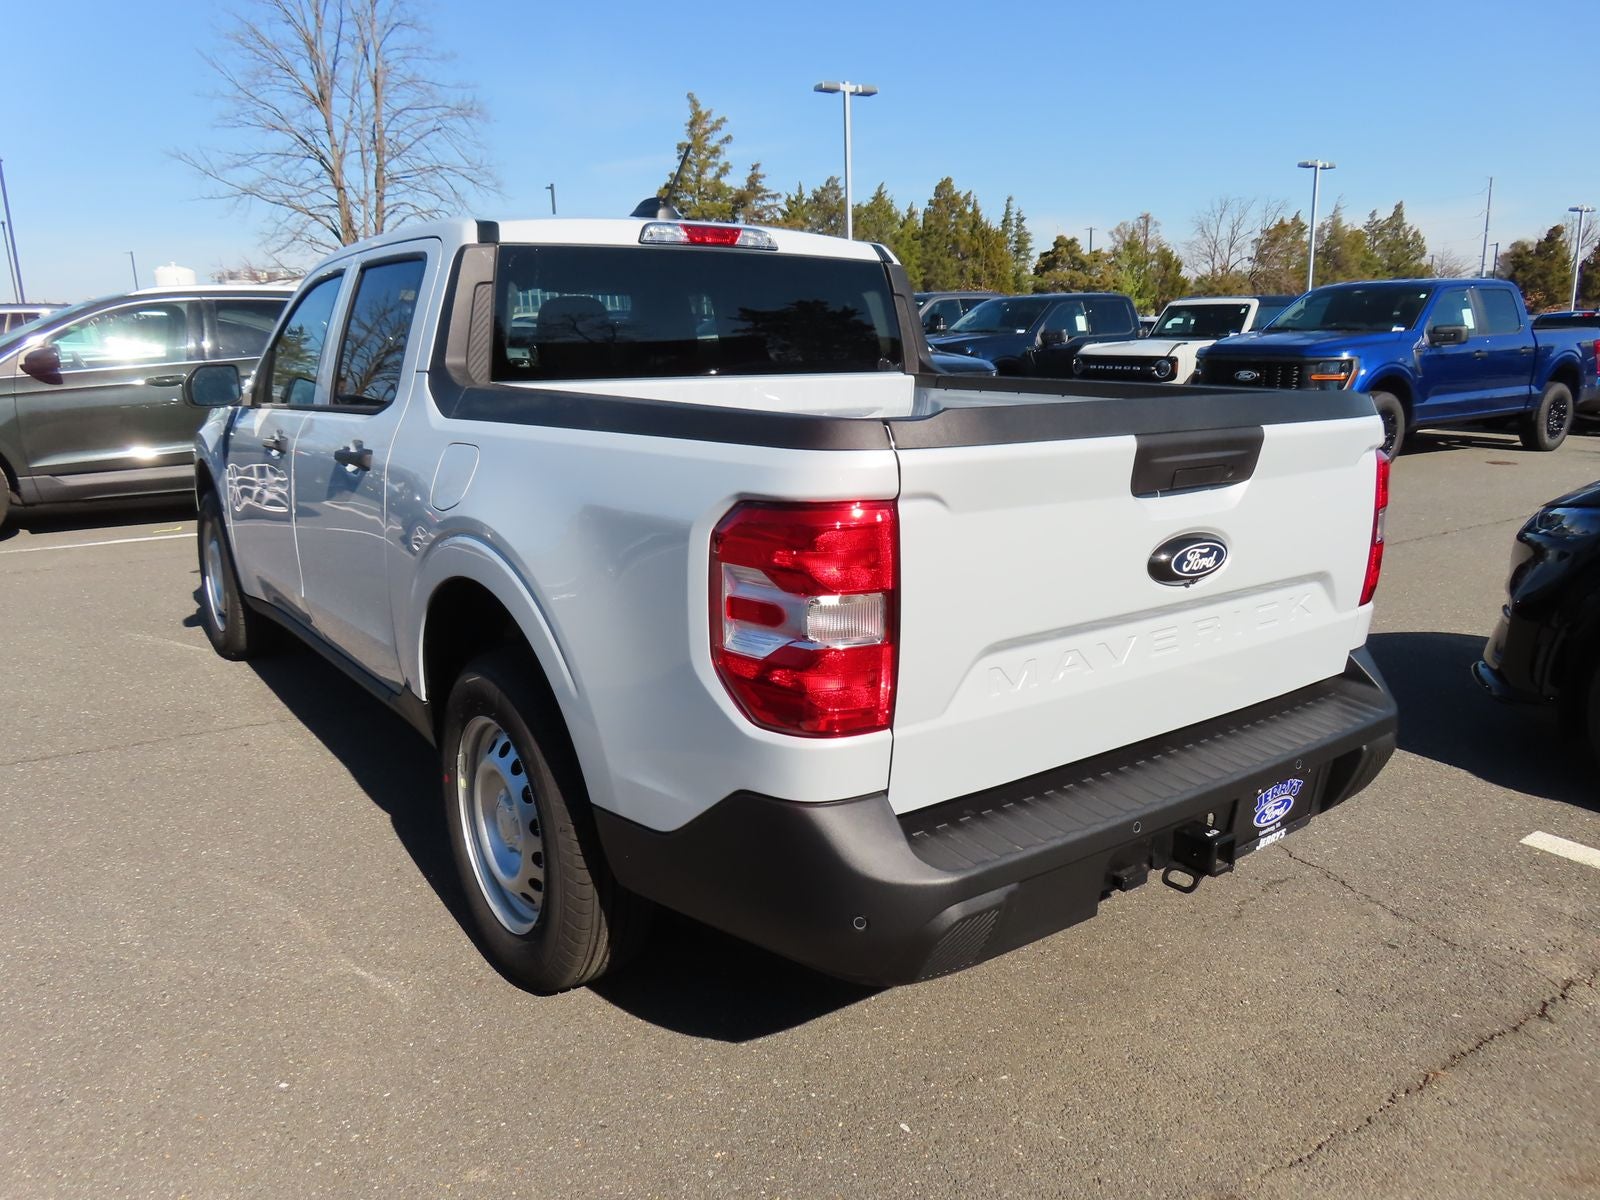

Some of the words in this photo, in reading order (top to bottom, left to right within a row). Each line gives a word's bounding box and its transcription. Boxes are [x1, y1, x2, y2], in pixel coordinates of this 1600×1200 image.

[1182, 547, 1217, 572] Ford
[987, 592, 1314, 698] MAVERICK
[1260, 801, 1288, 824] Ford
